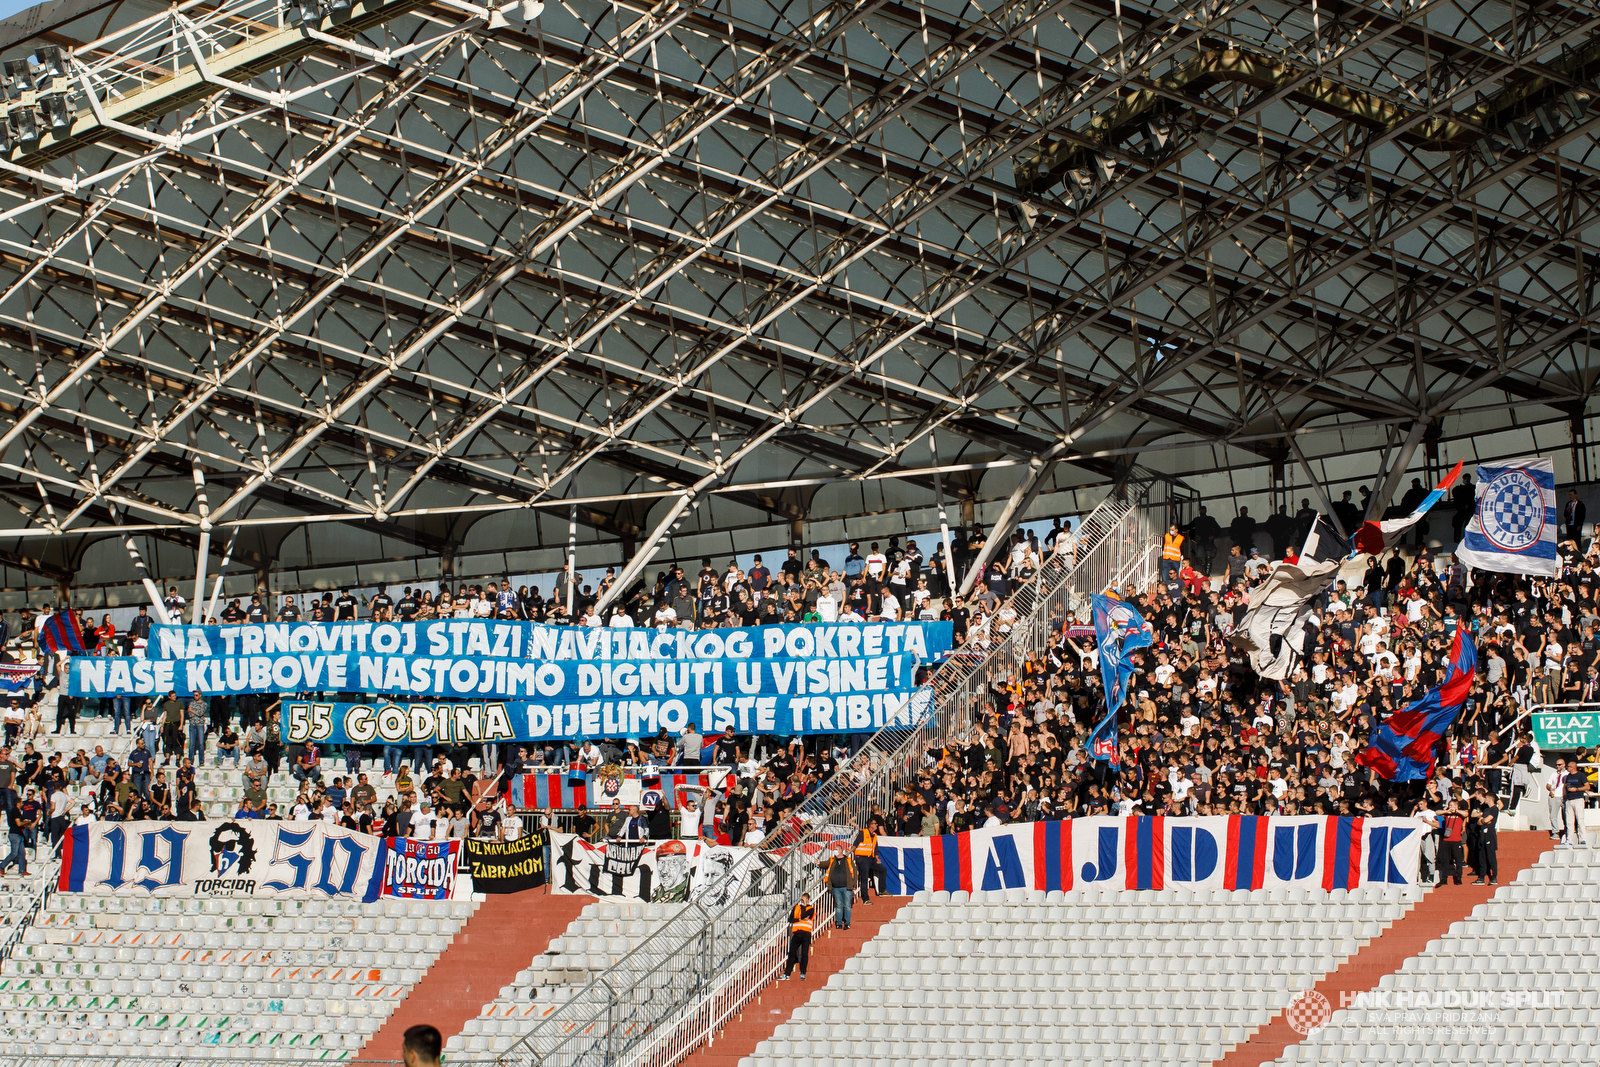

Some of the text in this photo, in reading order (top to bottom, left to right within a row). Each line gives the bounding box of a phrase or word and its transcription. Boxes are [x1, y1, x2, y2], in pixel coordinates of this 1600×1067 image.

[160, 628, 212, 659] NA
[220, 622, 416, 658] TRNOVITOJ
[427, 622, 522, 657] STAZI
[187, 654, 348, 693] KLUBOVE
[359, 656, 565, 696] NASTOJIMO
[578, 662, 723, 696] DIGNUTI
[736, 662, 761, 694] U
[771, 655, 902, 695] VISINE!
[289, 703, 334, 742] 55
[345, 702, 516, 743] GODINA
[527, 699, 688, 738] DIJELIMO
[701, 696, 777, 732] ISTE
[1540, 716, 1593, 729] IZLAZ
[1547, 731, 1587, 744] EXIT
[467, 840, 483, 855] UZ
[531, 834, 543, 848] SA
[386, 848, 457, 891] TORCIDA
[472, 857, 543, 878] ZABRANOM
[878, 823, 1416, 895] HAJDUK
[194, 879, 257, 895] TORCIDA
[397, 886, 439, 896] SPLIT
